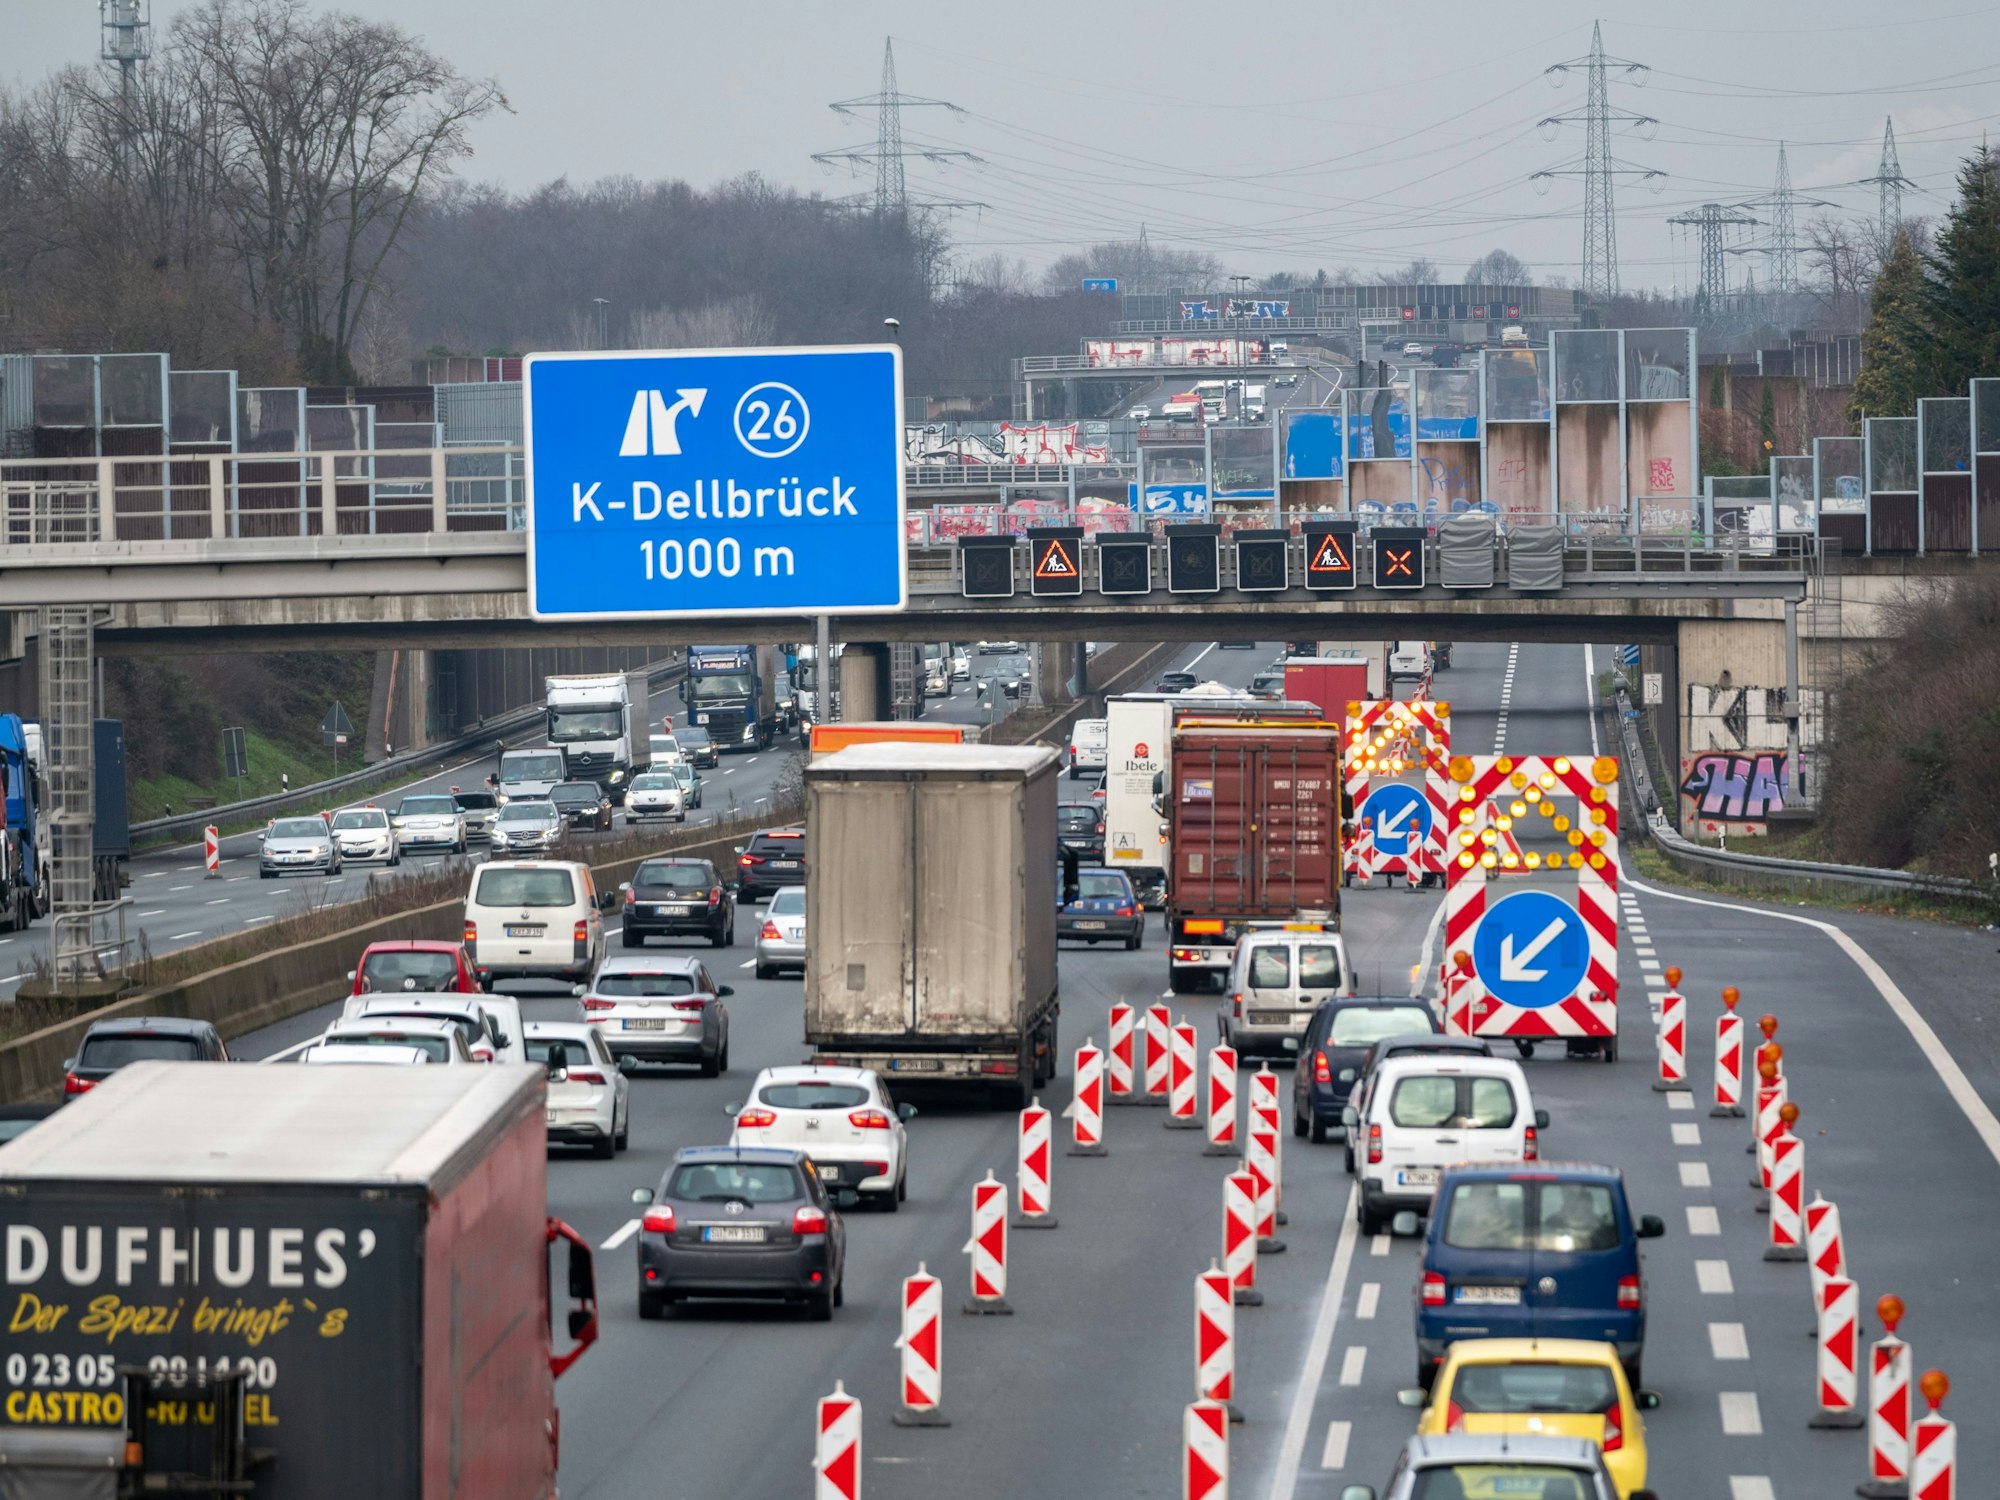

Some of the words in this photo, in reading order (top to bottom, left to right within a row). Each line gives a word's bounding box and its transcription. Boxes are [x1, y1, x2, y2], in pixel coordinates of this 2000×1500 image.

[747, 400, 797, 440] 26
[572, 476, 858, 522] K-Dellbrück
[640, 537, 741, 580] 1000
[754, 546, 795, 577] m
[1125, 760, 1157, 772] Ibele
[1118, 834, 1129, 847] A
[9, 1293, 69, 1334] Der
[79, 1294, 185, 1345] Spezi
